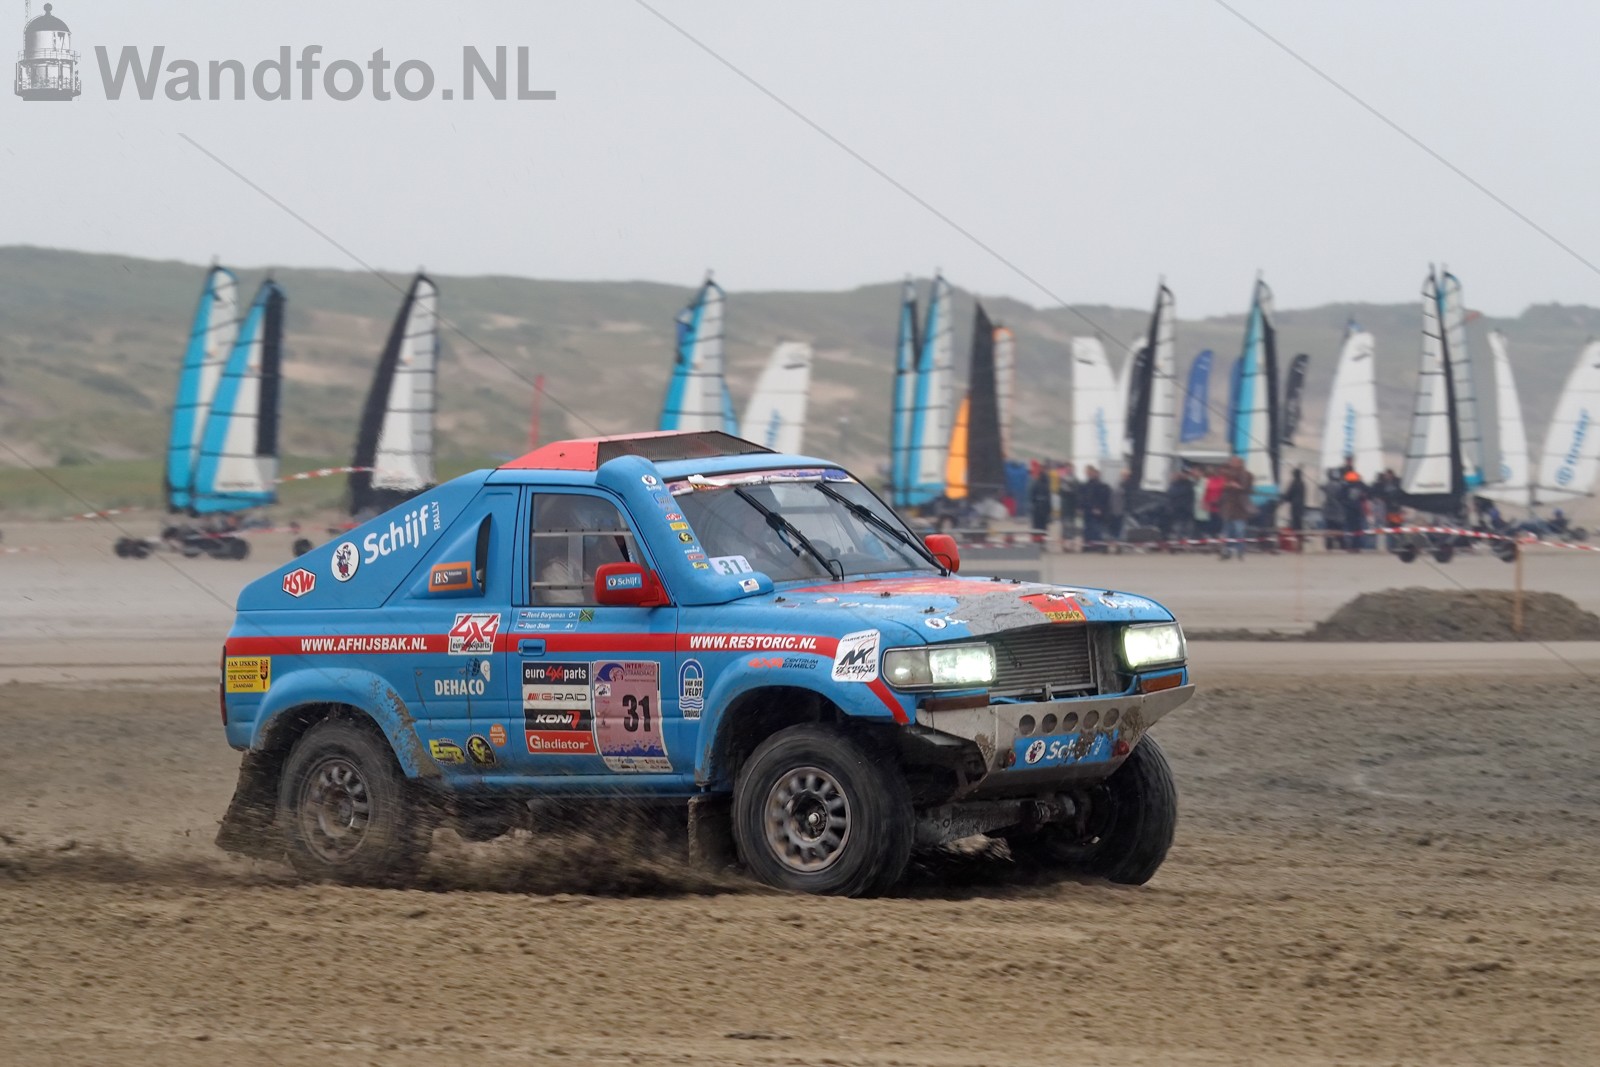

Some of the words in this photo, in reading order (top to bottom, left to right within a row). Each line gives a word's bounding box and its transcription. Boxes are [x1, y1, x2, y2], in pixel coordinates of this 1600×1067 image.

[431, 501, 441, 531] RALLY
[363, 504, 429, 564] Schijf
[718, 559, 744, 575] 31
[283, 570, 315, 594] HSW
[617, 577, 637, 586] Schijf
[301, 637, 427, 652] WWW.AFHIJSBAK.NL
[690, 635, 817, 650] WWW.RESTORIC.NL
[434, 679, 485, 696] DEHACO
[685, 688, 703, 697] VELDT
[535, 714, 573, 724] KONI
[622, 694, 651, 732] 31
[529, 735, 589, 749] Gladiator
